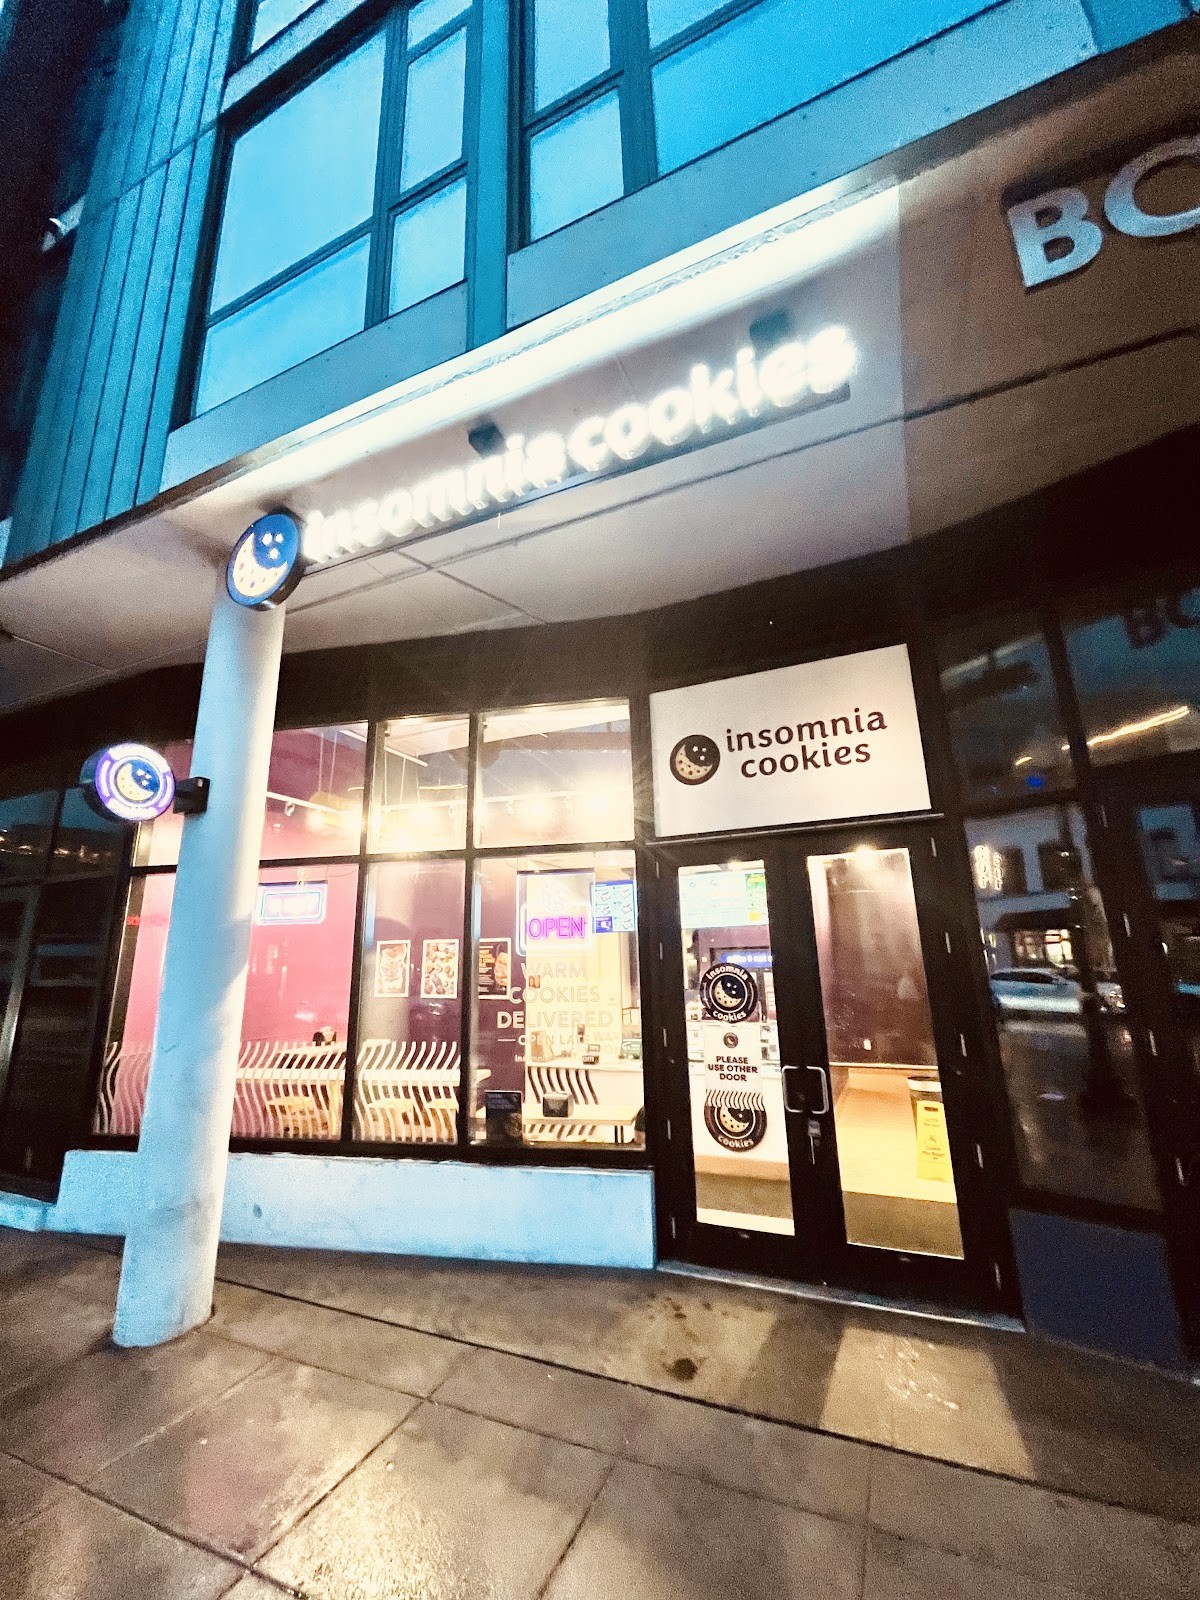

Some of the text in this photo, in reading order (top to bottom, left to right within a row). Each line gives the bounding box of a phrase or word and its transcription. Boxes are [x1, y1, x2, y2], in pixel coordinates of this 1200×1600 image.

[303, 325, 857, 563] insomnia cookies
[726, 707, 888, 752] insomnia
[741, 741, 871, 778] cookies
[529, 916, 586, 940] OPEN
[521, 962, 587, 979] WARM
[706, 965, 749, 981] insomnia
[509, 985, 601, 1005] COOKIES
[497, 1010, 613, 1029] DELIVERED
[713, 1010, 747, 1022] cookies
[518, 1034, 554, 1046] OPEN
[716, 1056, 749, 1065] PLEASE
[708, 1064, 759, 1074] USE OTHER
[720, 1073, 747, 1082] DOOR
[718, 1135, 754, 1149] cookies
